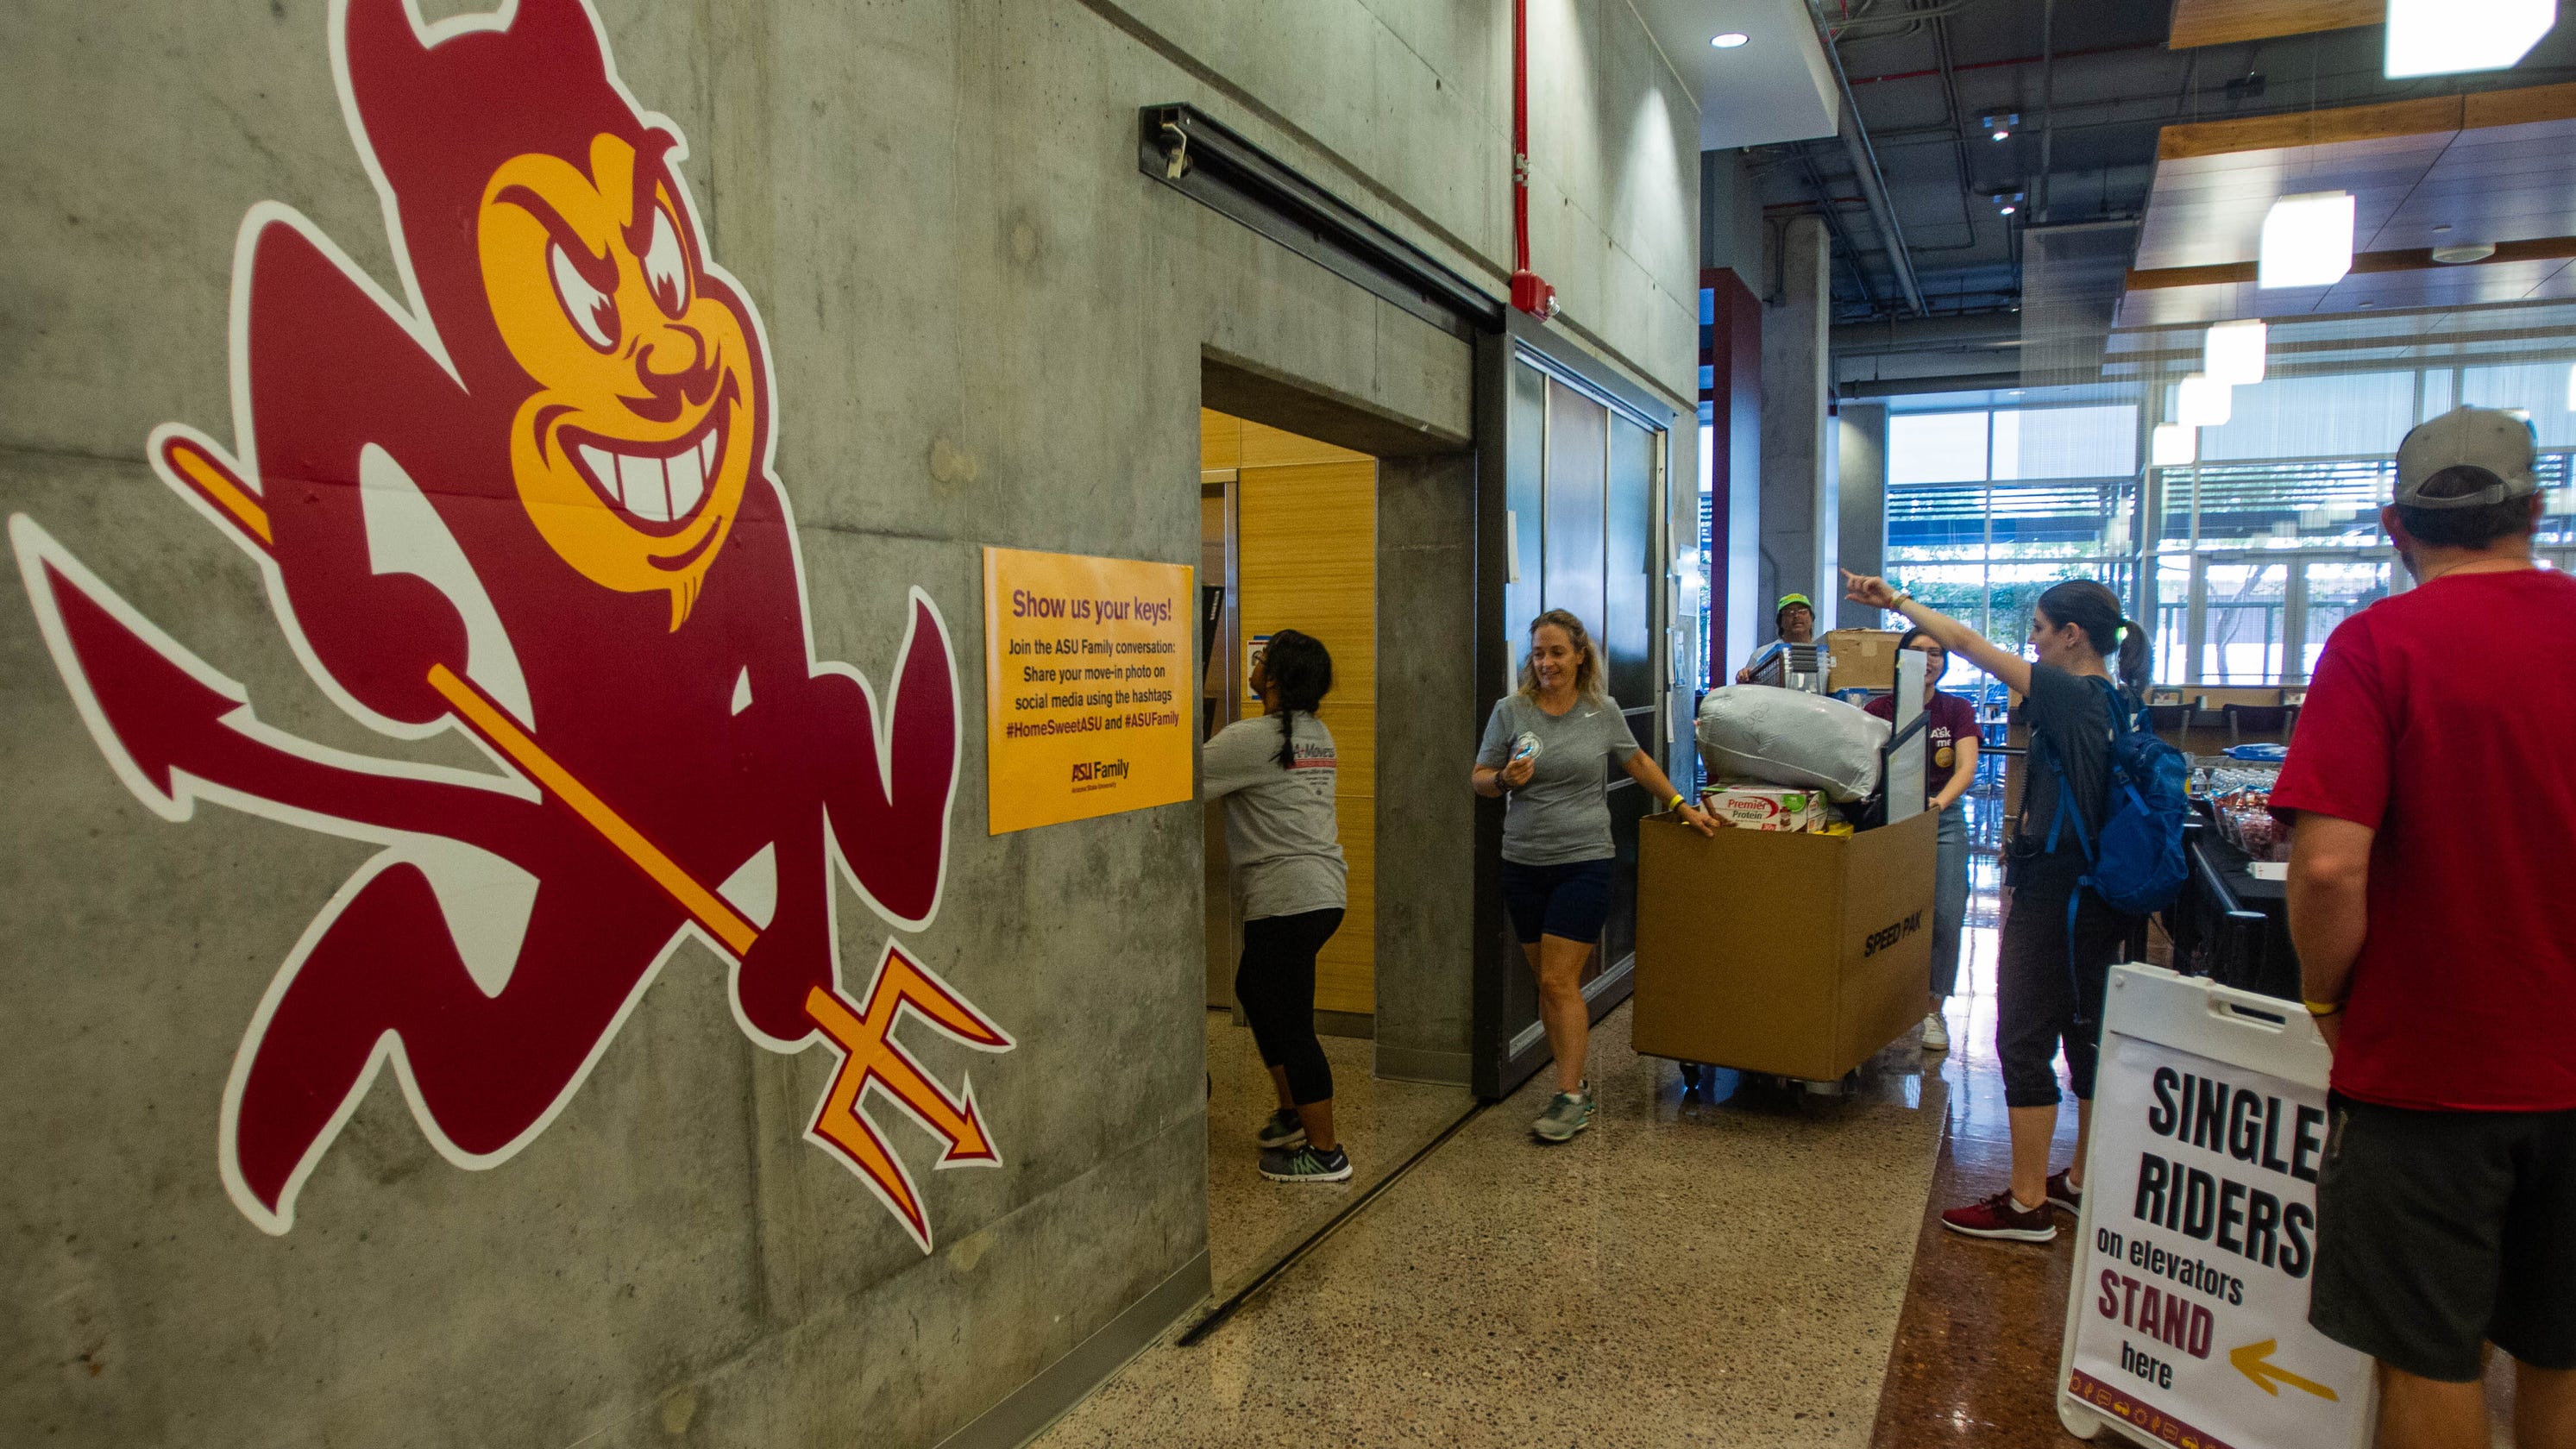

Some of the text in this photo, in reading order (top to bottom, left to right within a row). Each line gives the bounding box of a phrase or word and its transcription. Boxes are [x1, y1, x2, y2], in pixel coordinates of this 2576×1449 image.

[1013, 589, 1172, 626] Show us your keys!
[1008, 639, 1176, 657] Join the ASU Family conversation:
[1024, 664, 1165, 684] Share your move-in photo on
[1015, 689, 1172, 710] social media using the hashtags
[1006, 711, 1179, 738] #HomeSweetASU and #ASUFamily
[1930, 727, 1951, 738] Ask
[1071, 759, 1129, 782] ASU Family
[1727, 799, 1768, 810] Premier
[1732, 810, 1762, 820] Protein
[1864, 909, 1923, 958] SPEED PAK
[2148, 1065, 2326, 1185] SINGLE
[2133, 1151, 2315, 1279] RIDERS
[2097, 1226, 2244, 1307] on elevators
[2098, 1268, 2215, 1360] STAND
[2120, 1340, 2173, 1389] here
